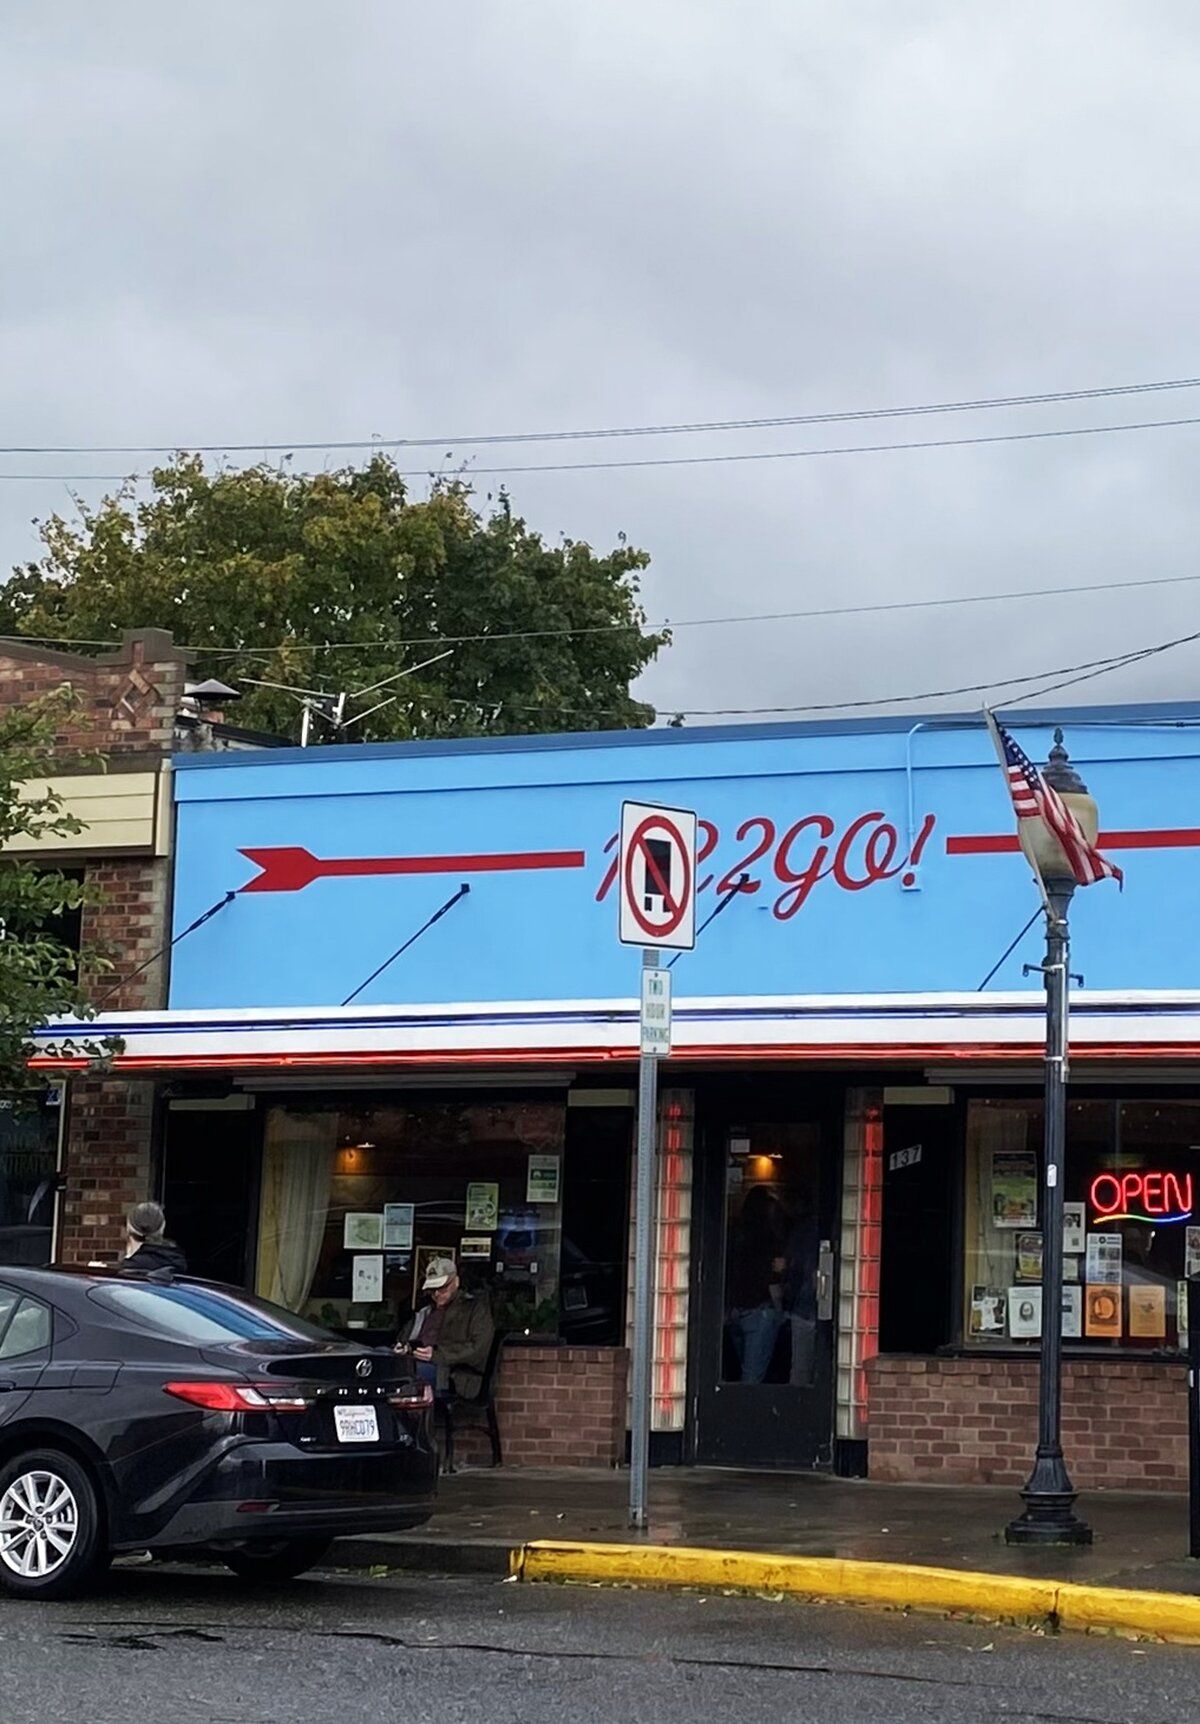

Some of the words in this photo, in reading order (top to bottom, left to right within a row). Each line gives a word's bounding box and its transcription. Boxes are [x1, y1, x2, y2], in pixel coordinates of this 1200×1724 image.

[596, 812, 935, 920] 2GO!
[892, 1146, 920, 1168] 137
[1091, 1173, 1192, 1212] OPEN
